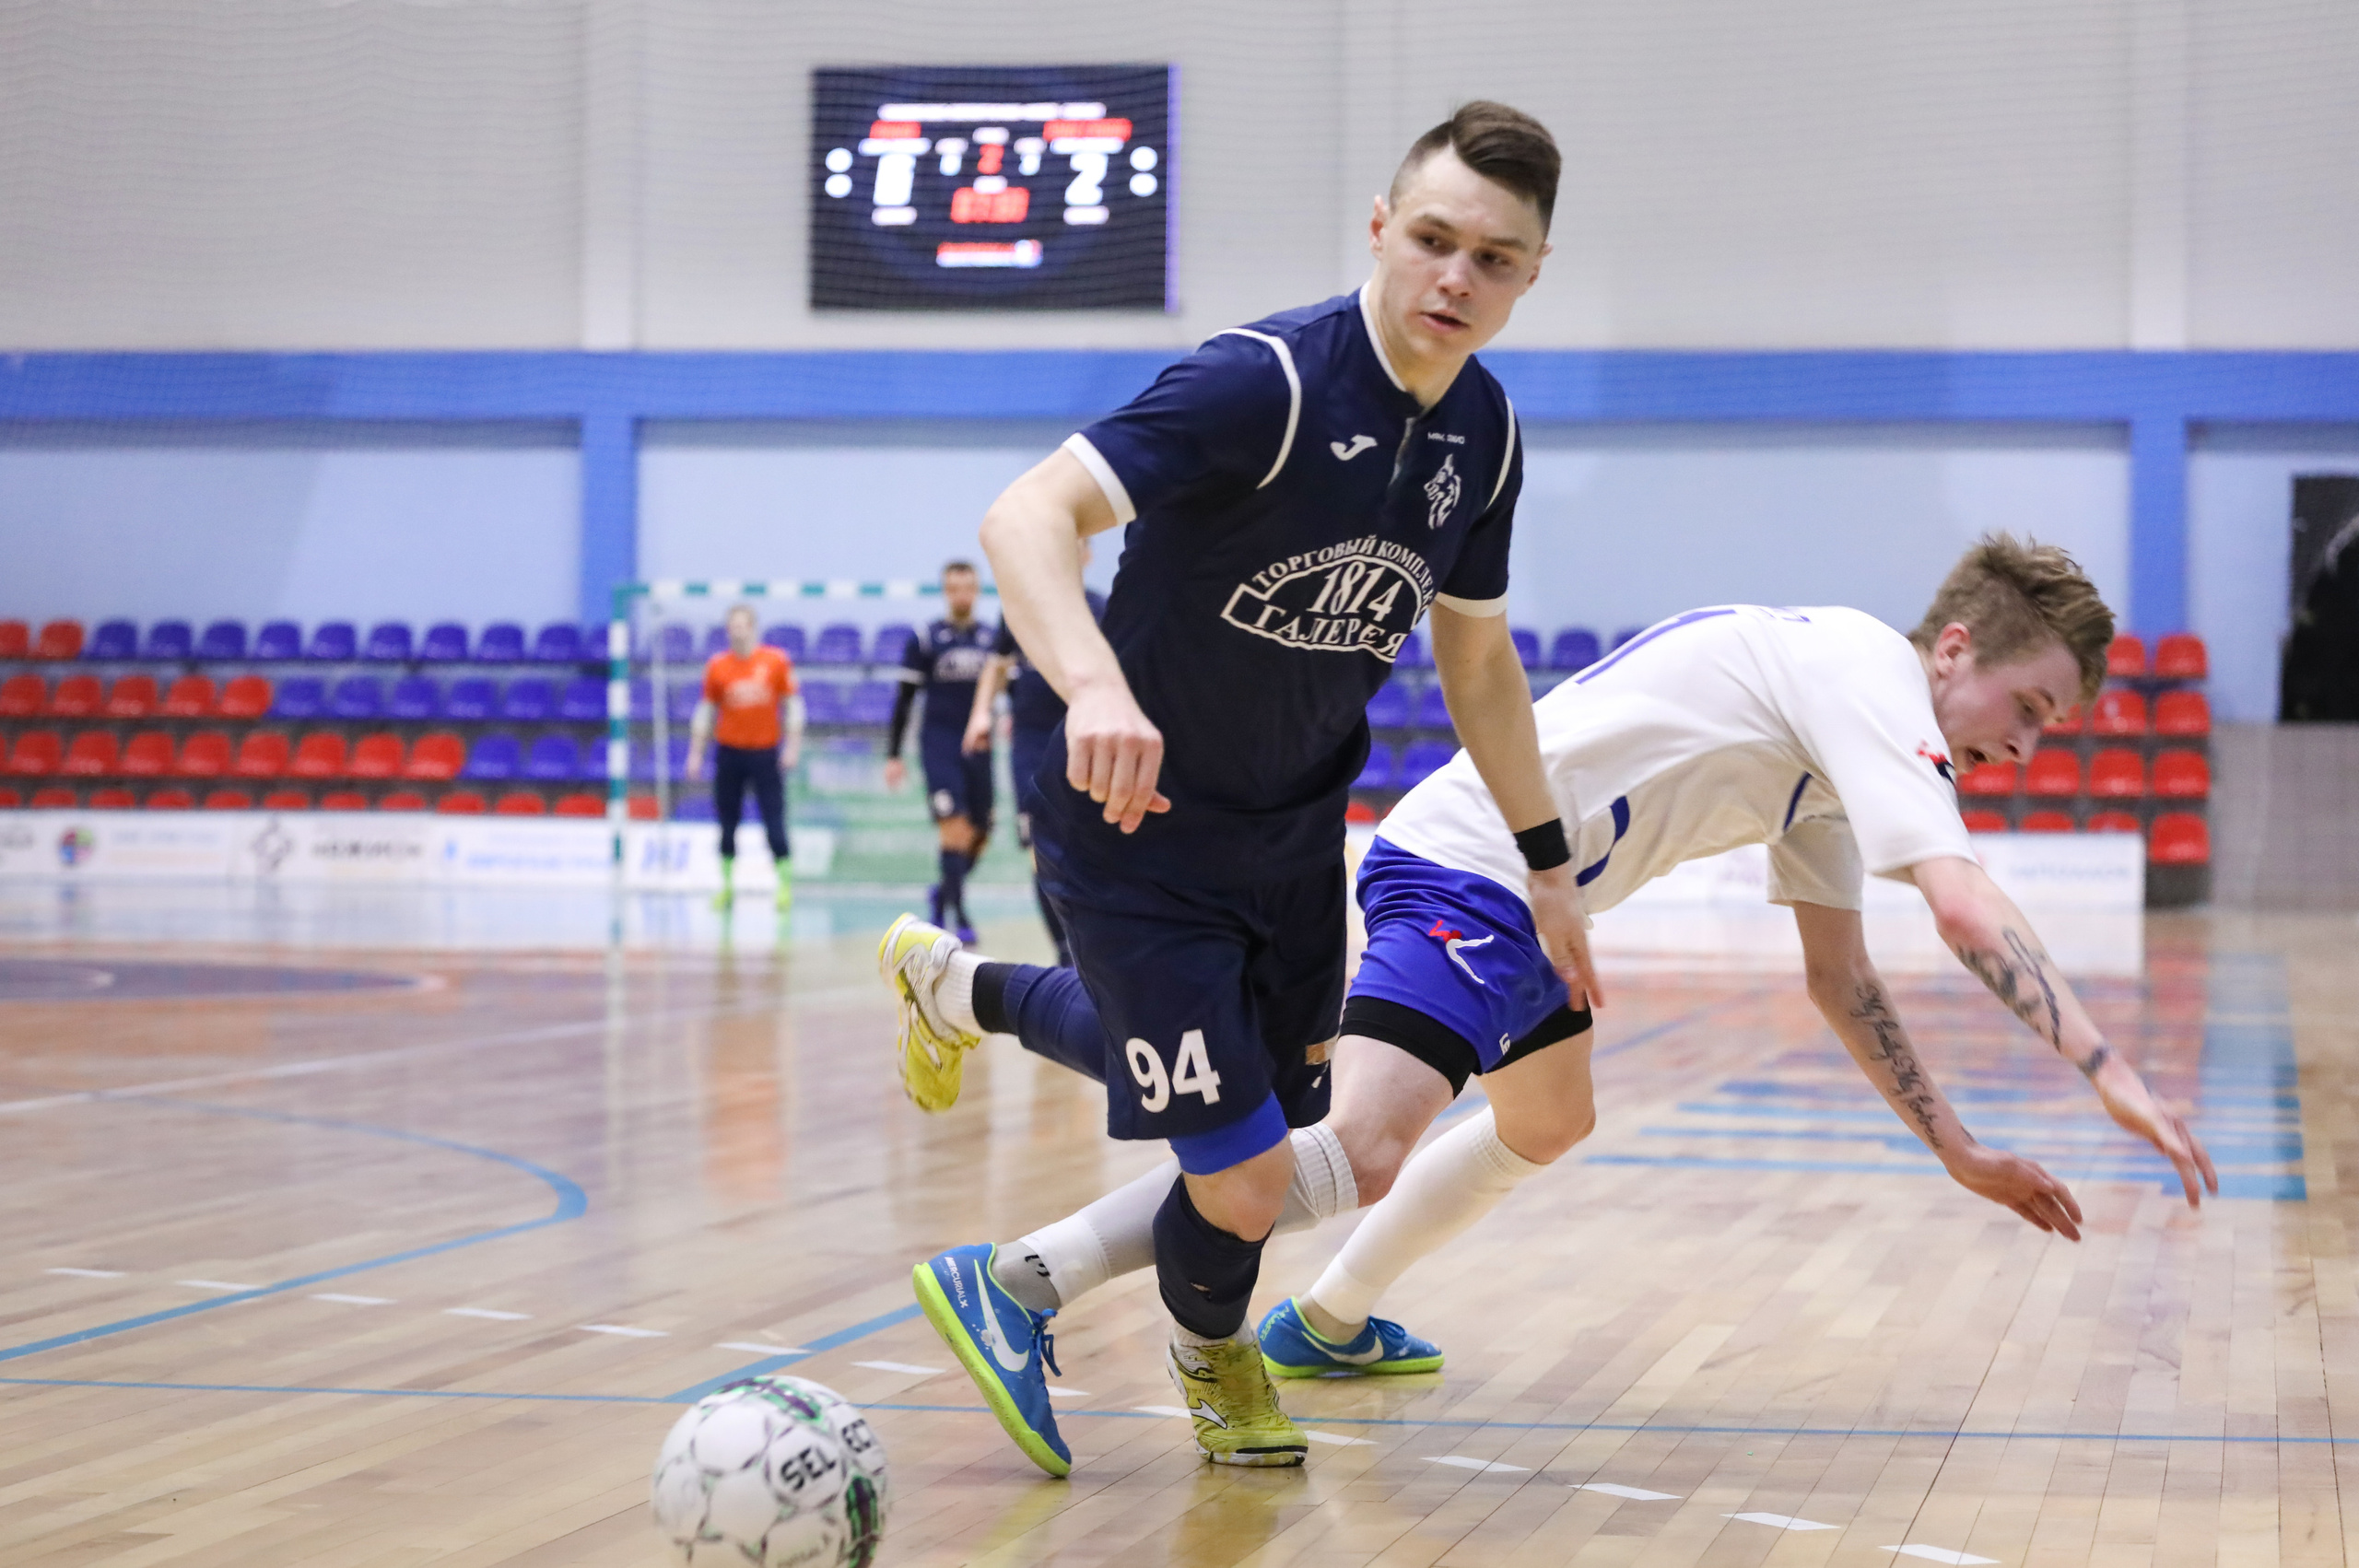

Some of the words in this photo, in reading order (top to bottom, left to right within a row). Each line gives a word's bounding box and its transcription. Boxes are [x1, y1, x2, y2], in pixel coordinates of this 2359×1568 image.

[1251, 533, 1378, 588] ТОРГОВЫЙ
[1305, 560, 1403, 622] 1814
[1252, 603, 1409, 657] ГАЛЕРЕЯ
[1125, 1028, 1222, 1113] 94
[780, 1447, 837, 1492] SEL
